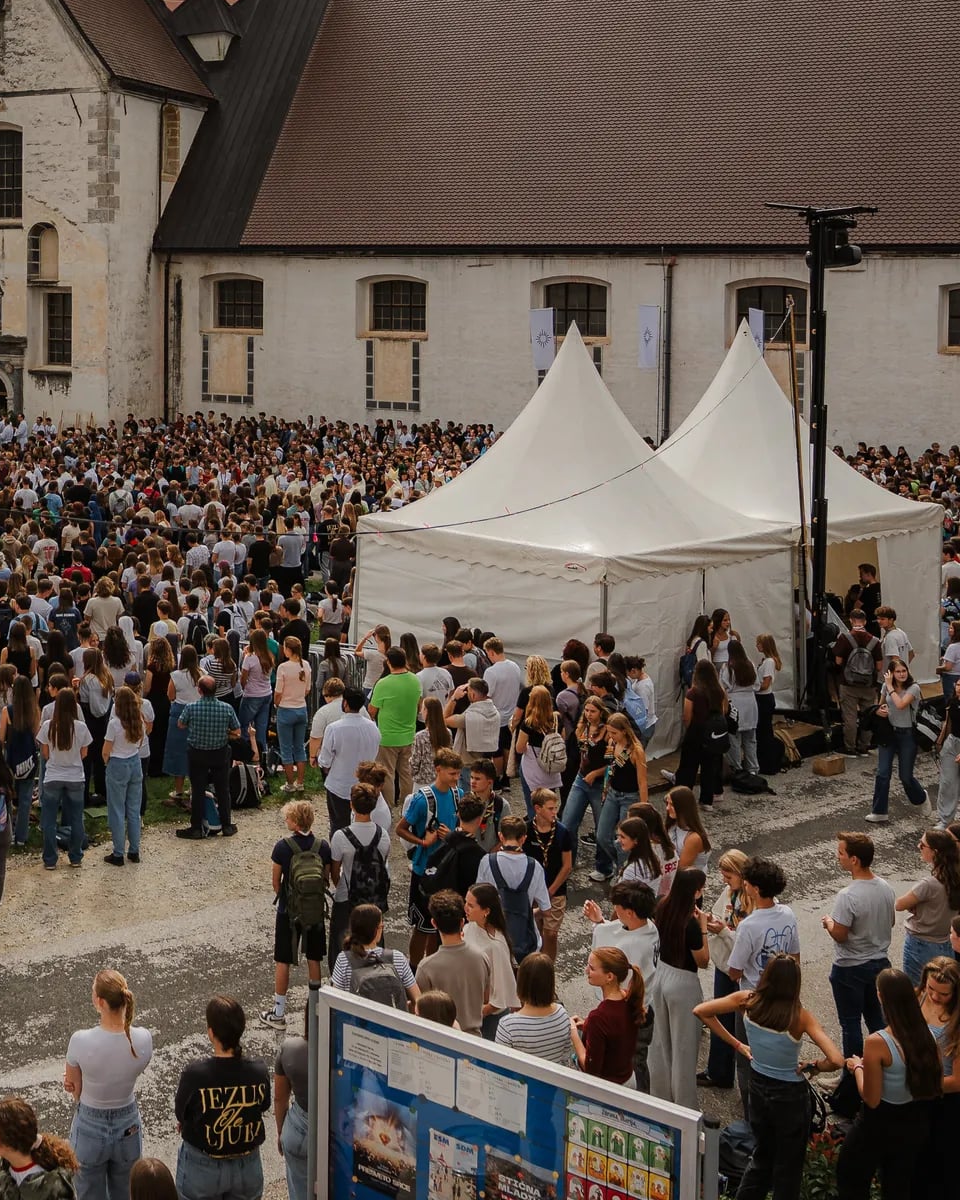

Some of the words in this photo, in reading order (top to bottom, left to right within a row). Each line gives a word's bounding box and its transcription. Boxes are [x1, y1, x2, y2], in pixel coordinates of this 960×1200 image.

[198, 1083, 266, 1114] JEZUS
[204, 1120, 262, 1150] LJUBI
[498, 1173, 542, 1198] STIČNA
